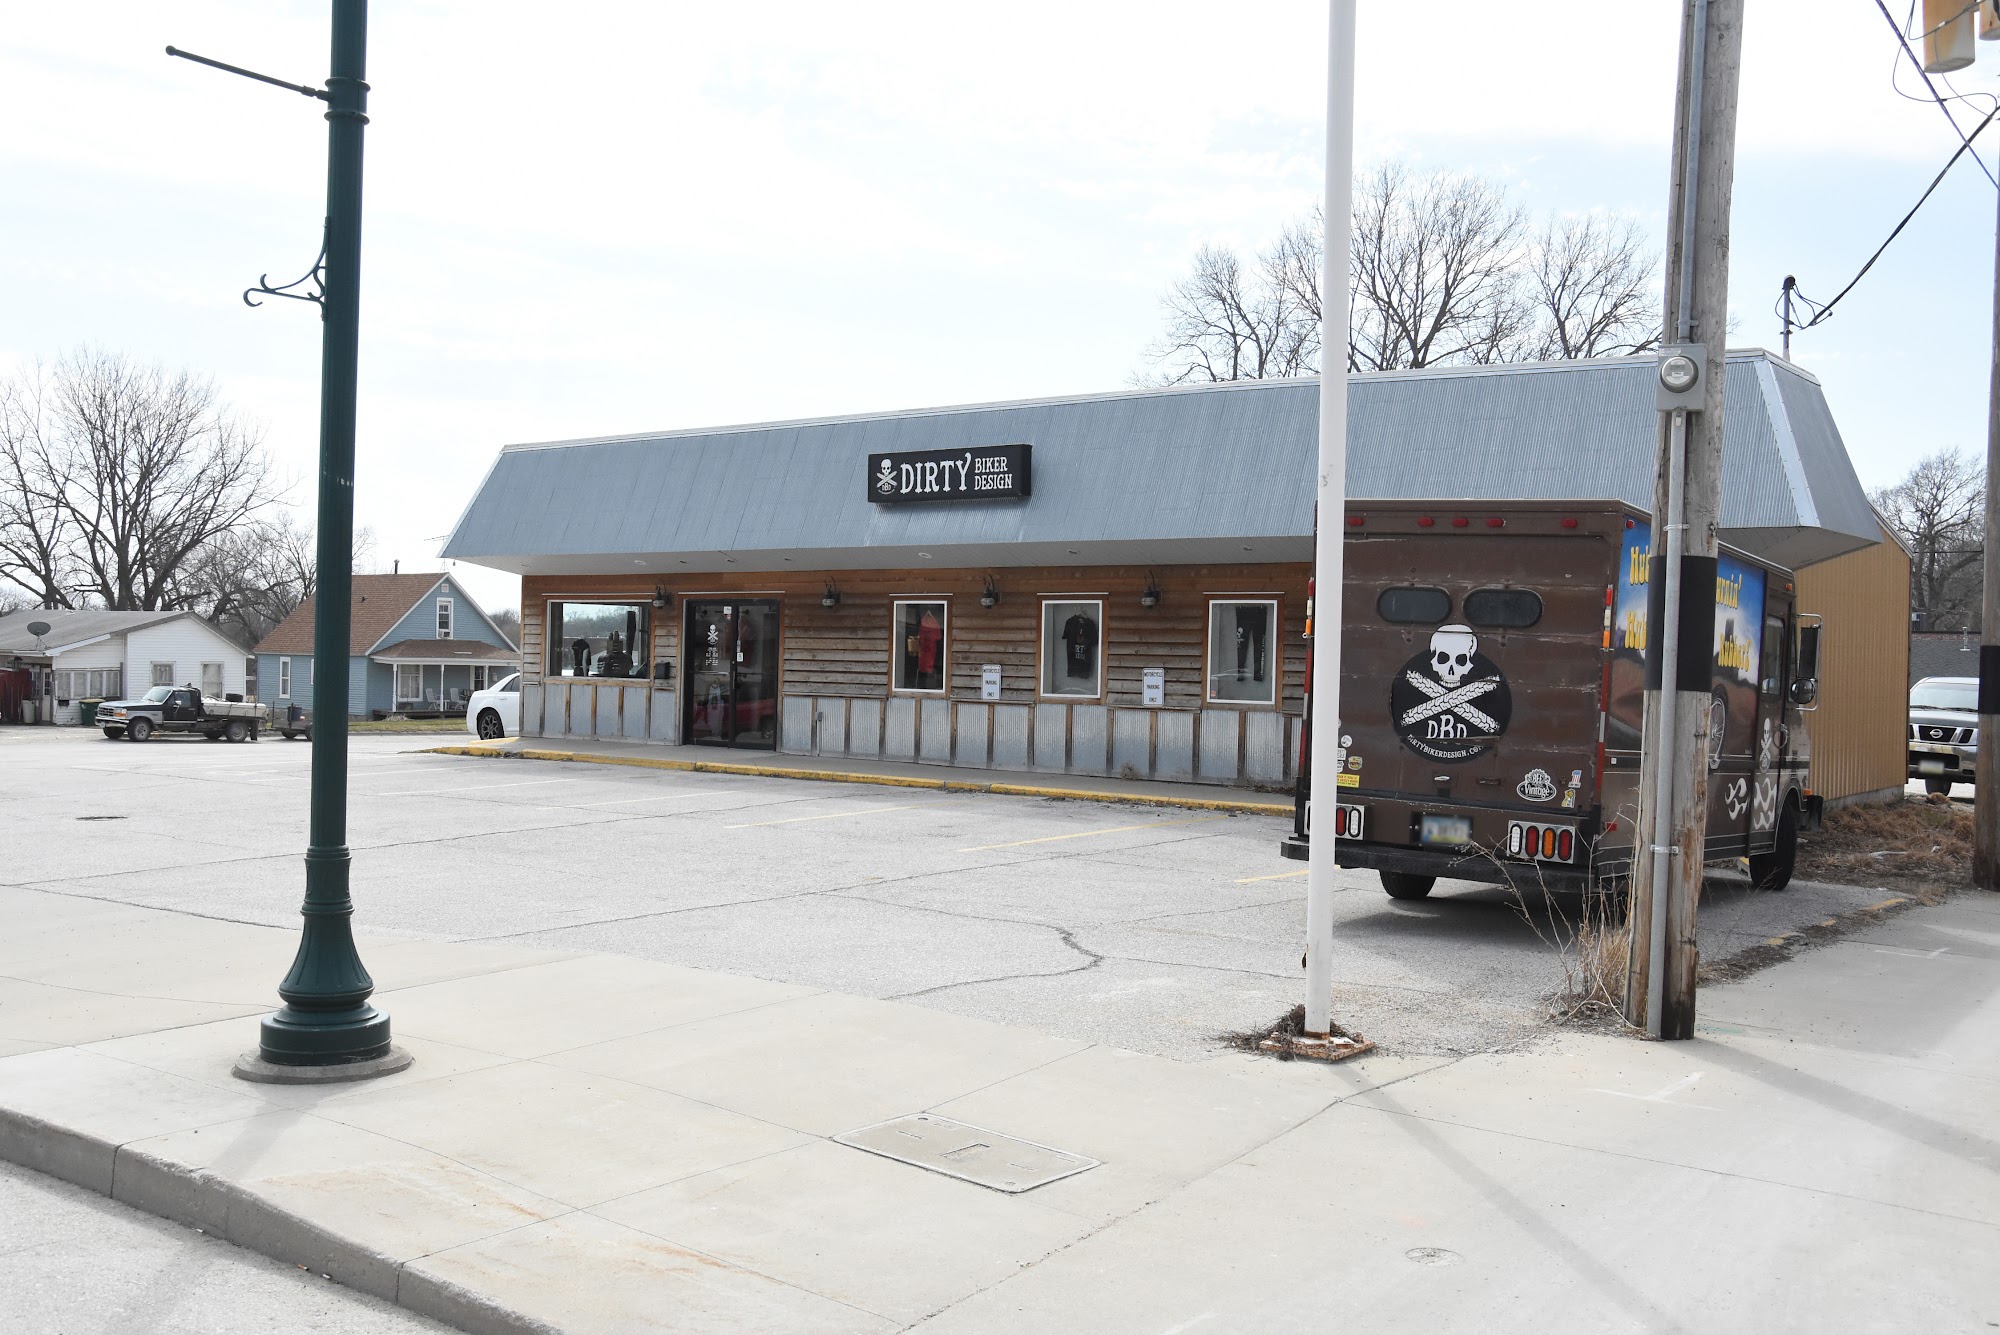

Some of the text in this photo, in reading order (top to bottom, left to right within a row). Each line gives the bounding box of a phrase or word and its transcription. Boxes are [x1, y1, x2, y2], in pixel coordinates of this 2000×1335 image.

[900, 452, 972, 494] DIRTY
[974, 457, 1008, 473] BIKER
[974, 473, 1013, 490] DESIGN
[1629, 545, 1743, 609] Hub urnin'
[1624, 610, 1647, 650] Hub
[1426, 714, 1468, 739] DBD
[1524, 782, 1550, 798] Vintage
